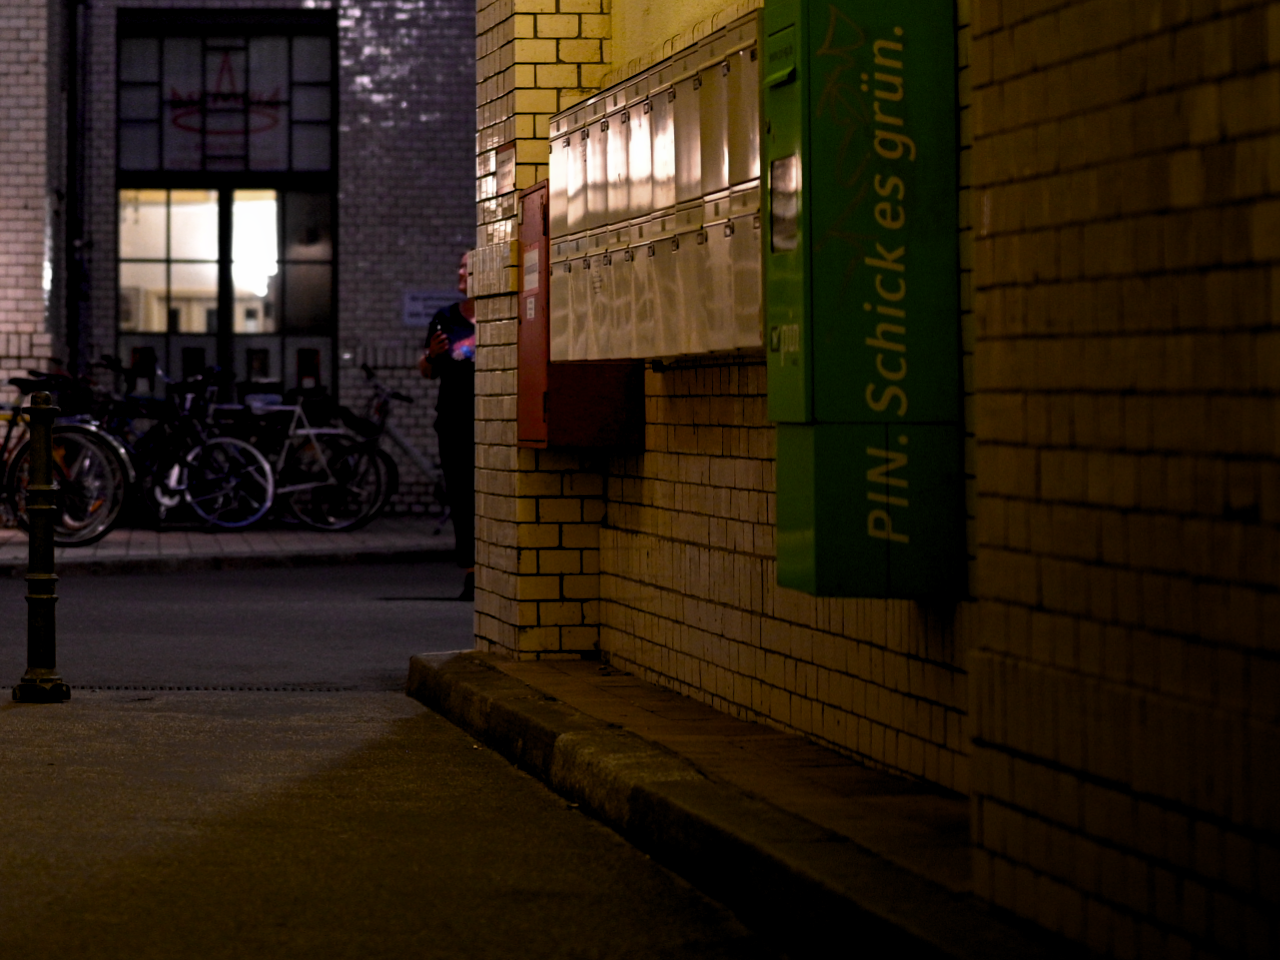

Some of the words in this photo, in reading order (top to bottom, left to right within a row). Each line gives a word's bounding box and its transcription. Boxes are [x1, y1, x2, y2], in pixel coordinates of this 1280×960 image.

[860, 24, 916, 162] grün.
[875, 173, 906, 230] es
[864, 244, 908, 417] Schick
[865, 432, 910, 544] PIN.
